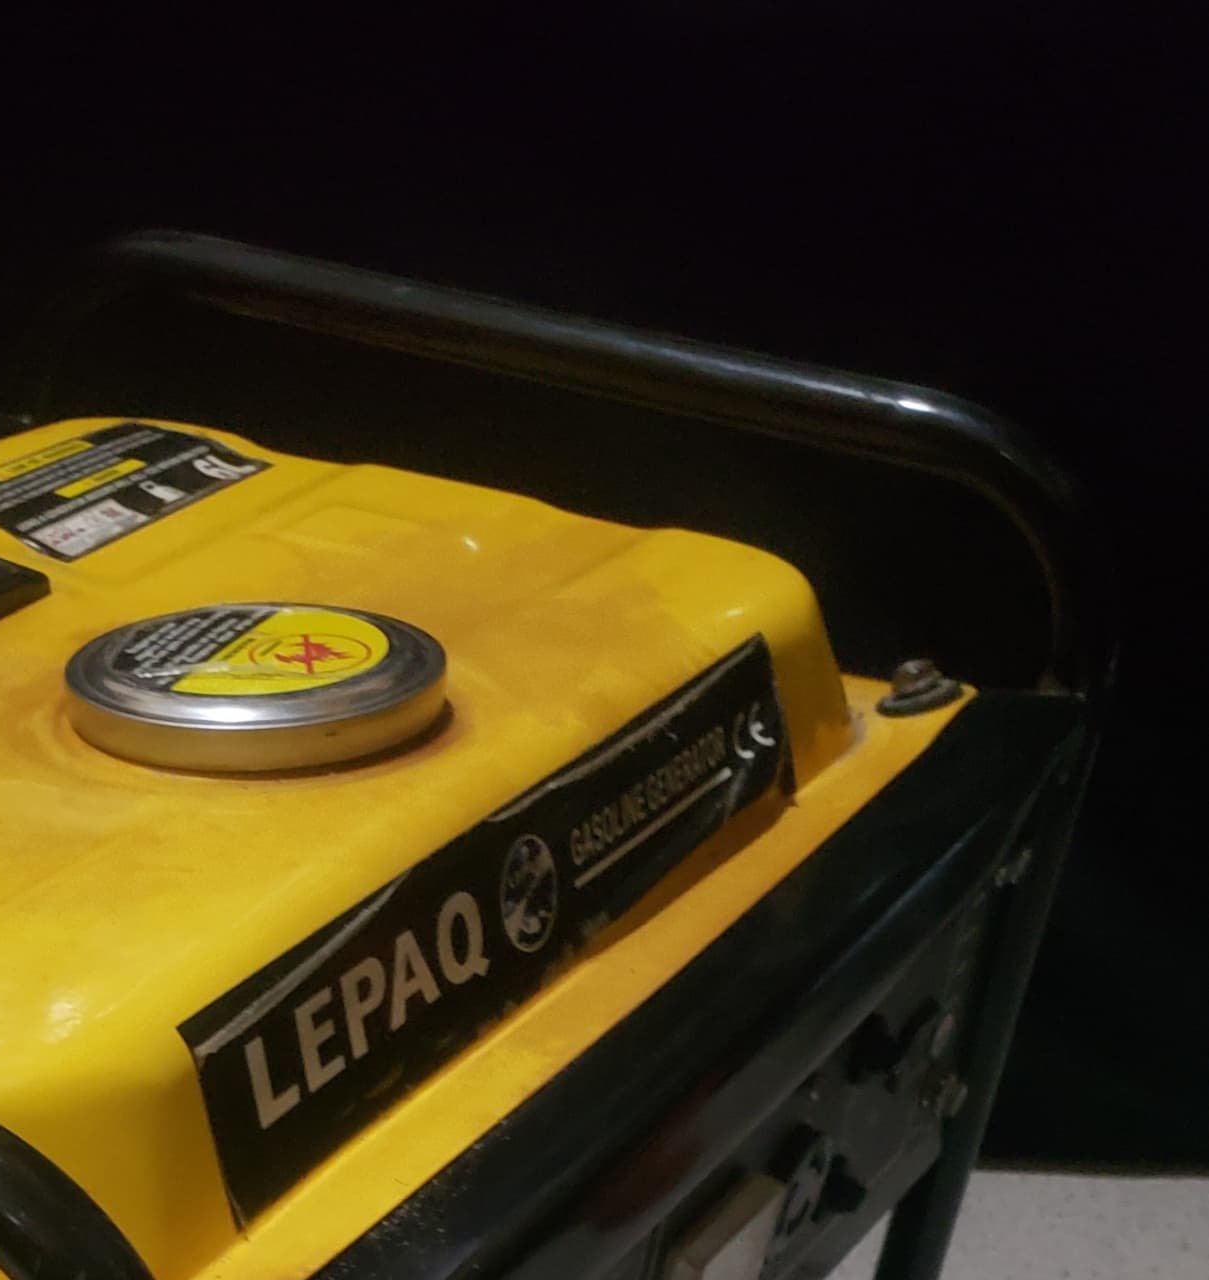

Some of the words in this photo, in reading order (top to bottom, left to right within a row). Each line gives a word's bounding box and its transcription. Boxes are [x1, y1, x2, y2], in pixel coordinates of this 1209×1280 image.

[570, 782, 647, 866] GASOLINE
[646, 726, 726, 811] GENERATOR
[245, 890, 490, 1130] LEPAQ
